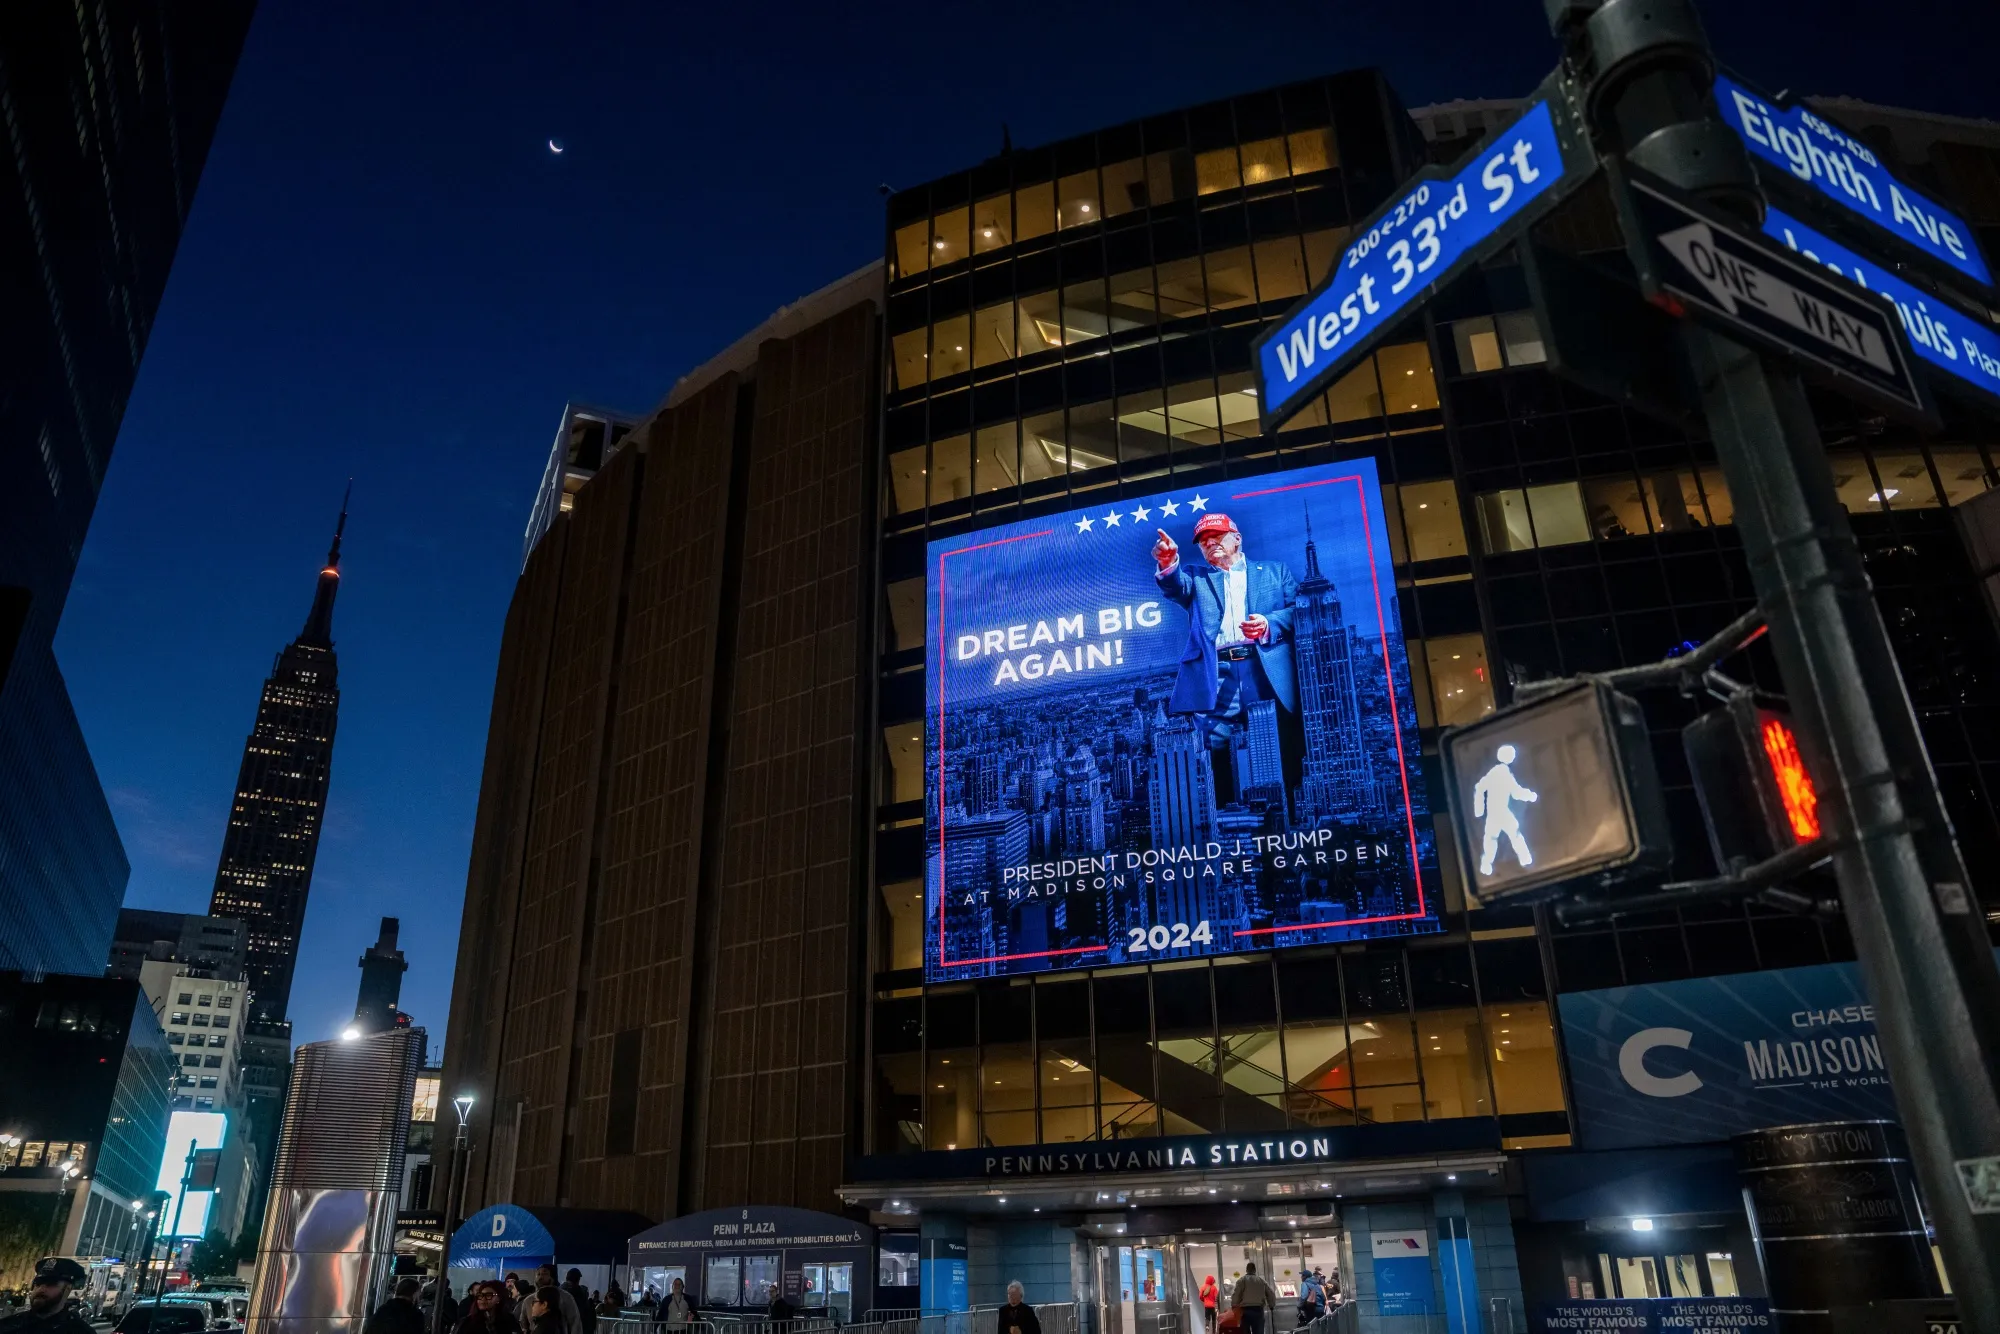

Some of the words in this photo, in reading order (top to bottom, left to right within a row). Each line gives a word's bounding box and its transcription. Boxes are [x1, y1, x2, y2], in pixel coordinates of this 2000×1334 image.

[1731, 89, 1882, 212] Eighth
[1889, 183, 1967, 260] Ave
[1276, 273, 1380, 383] West
[1386, 183, 1468, 294] 33rd
[1481, 139, 1540, 213] St
[1689, 240, 1767, 307] ONE
[1793, 292, 1867, 357] WAY
[958, 613, 1085, 661] DREAM
[1098, 601, 1162, 635] BIG
[993, 639, 1124, 686] AGAIN!
[1003, 854, 1119, 884] PRESIDENT
[1126, 841, 1222, 869] DONALD
[1230, 839, 1246, 857] J.
[1252, 828, 1333, 854] TRUMP
[963, 891, 990, 906] AT
[1008, 875, 1126, 900] MADISON
[1145, 859, 1254, 884] SQUARE
[1273, 843, 1389, 869] GARDEN
[1128, 919, 1214, 953] 2024
[1791, 1005, 1876, 1029] CHASE
[1618, 1027, 1704, 1098] C
[1744, 1034, 1886, 1082] MADISON
[1810, 1080, 1839, 1089] THE
[985, 1146, 1197, 1174] PENNSYLVANIA
[1211, 1138, 1331, 1165] STATION
[1793, 1129, 1873, 1157] STATION
[491, 1214, 507, 1237] D
[742, 1209, 748, 1220] 8
[409, 1230, 426, 1239] NICK
[638, 1241, 667, 1249] ENTRANCE
[680, 1240, 714, 1249] EMPLOYEES,
[715, 1239, 733, 1247] MEDIA
[748, 1237, 775, 1246] PATRONS
[776, 1236, 793, 1245] WITH
[793, 1235, 834, 1244] DISABILITIES
[835, 1234, 852, 1242] ONLY
[713, 1223, 738, 1235] PENN
[743, 1222, 776, 1234] PLAZA
[470, 1241, 488, 1250] CHASE
[493, 1240, 525, 1249] ENTRANCE
[1546, 1318, 1584, 1328] MOST
[1588, 1316, 1648, 1328] FAMOUS
[1556, 1307, 1579, 1317] THE
[1580, 1306, 1635, 1317] WORLD'S
[1662, 1317, 1702, 1328] MOST
[1706, 1315, 1769, 1327] FAMOUS
[1671, 1305, 1695, 1315] THE
[1698, 1304, 1754, 1315] WORLD'S
